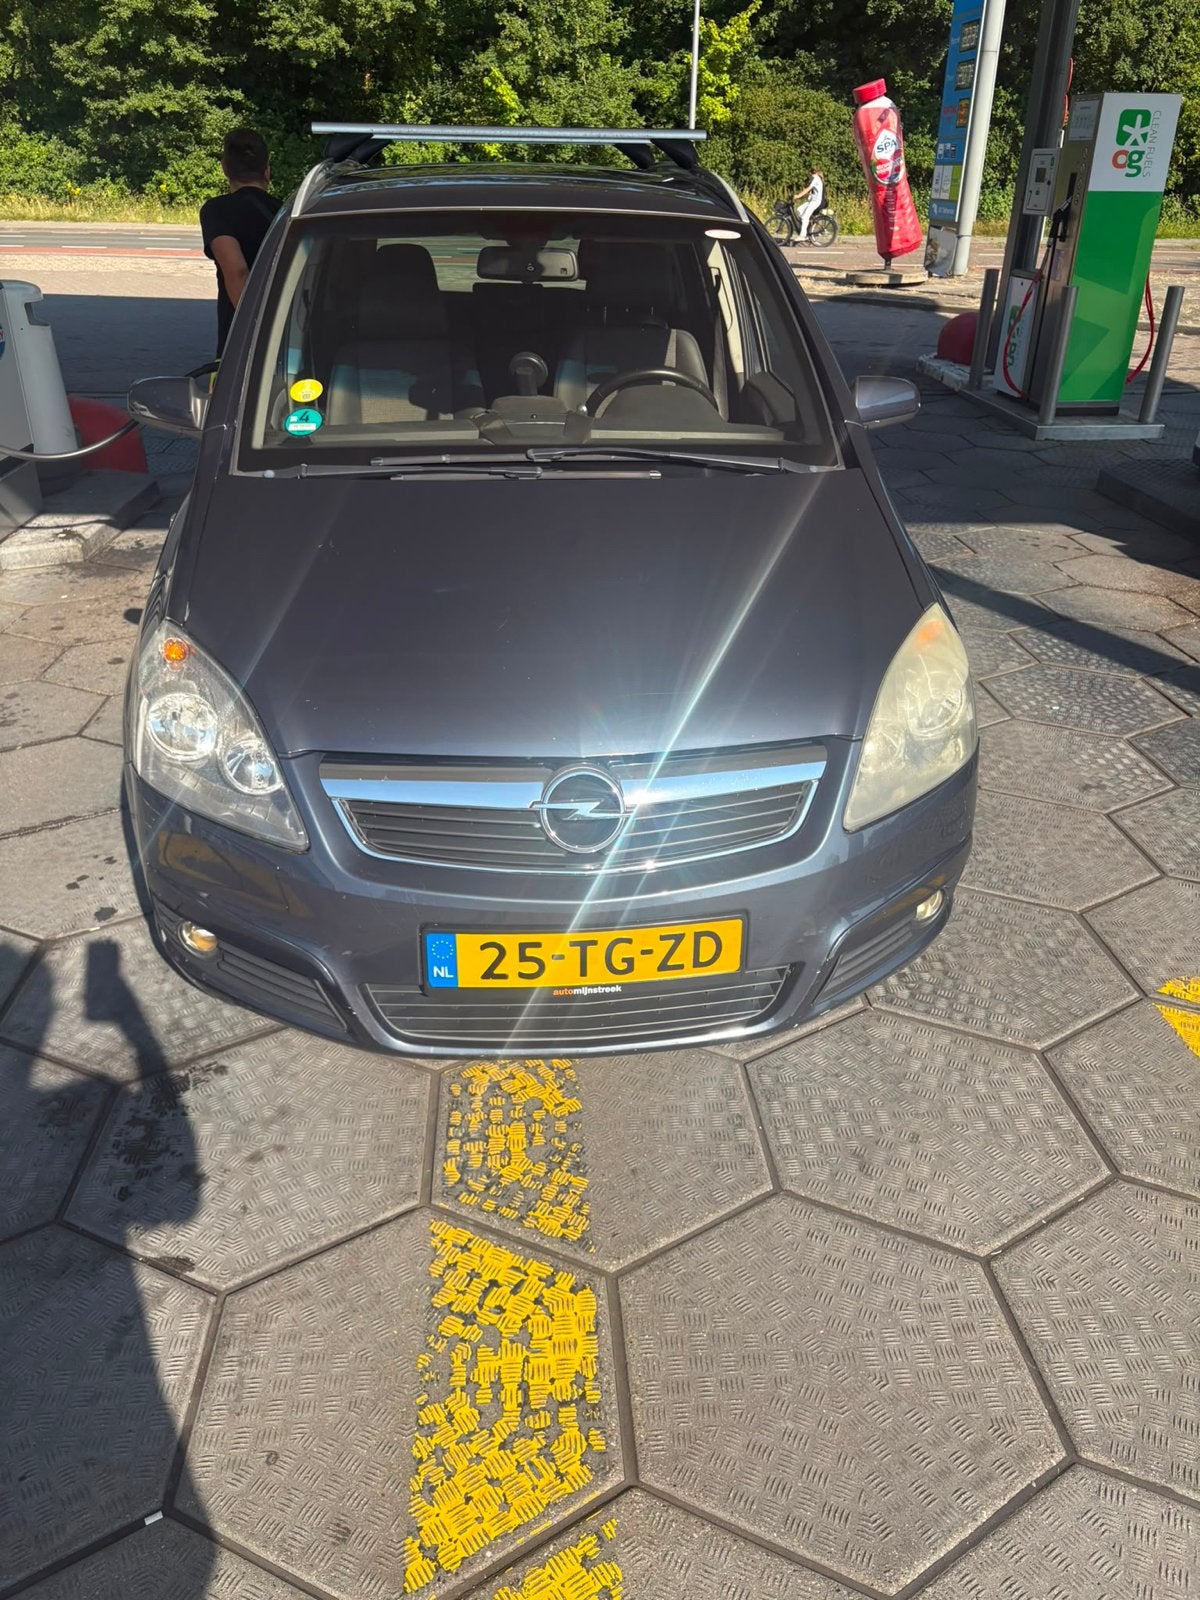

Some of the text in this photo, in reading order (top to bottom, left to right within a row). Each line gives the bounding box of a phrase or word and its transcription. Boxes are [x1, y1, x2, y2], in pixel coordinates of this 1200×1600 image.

[876, 139, 898, 153] SPA
[1143, 110, 1162, 178] CLEAN FUELS
[299, 410, 309, 422] 4
[479, 930, 723, 980] 25-TG-ZD
[432, 966, 454, 978] NL
[552, 985, 622, 996] automijnstreek
